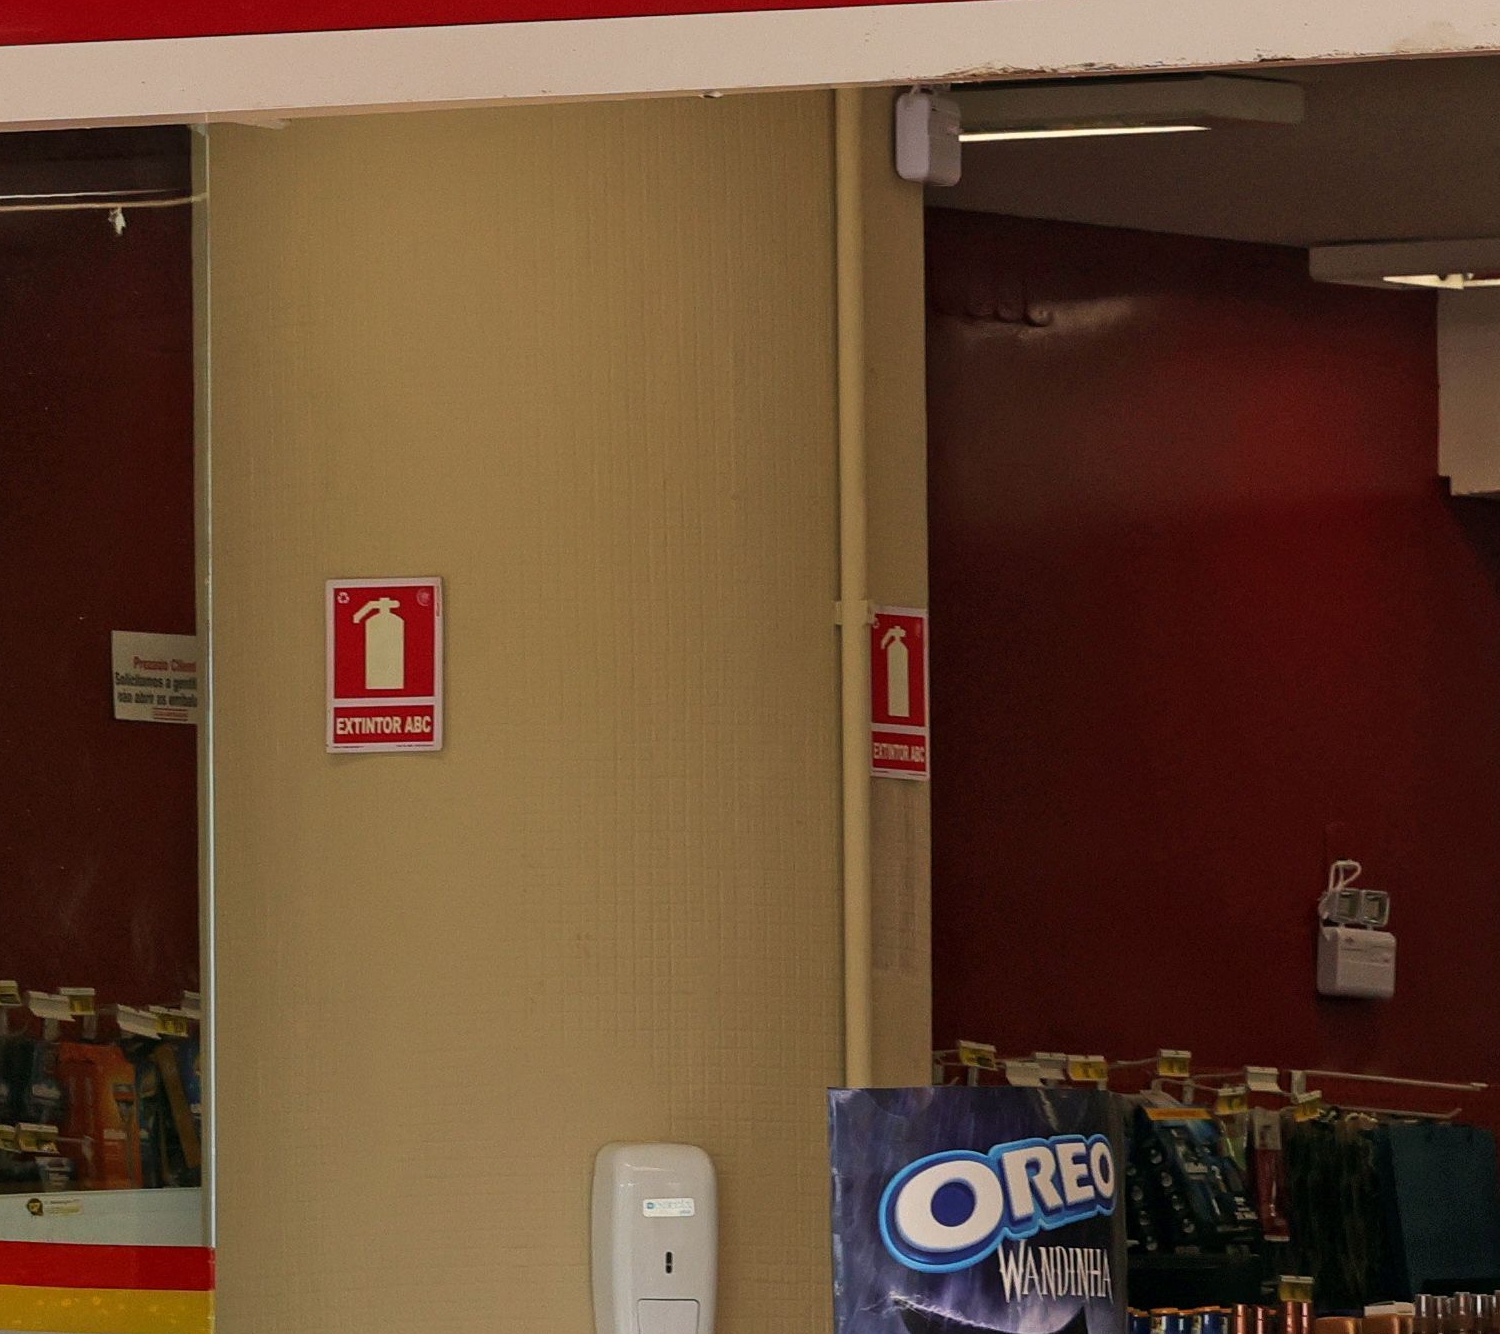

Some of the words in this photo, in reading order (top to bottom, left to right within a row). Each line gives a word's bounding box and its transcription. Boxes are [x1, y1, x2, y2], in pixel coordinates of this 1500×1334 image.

[336, 716, 402, 735] EXTINTOR
[404, 715, 431, 734] ABC
[873, 742, 908, 762] EXTINTOR
[909, 743, 925, 763] ABC
[894, 1141, 1114, 1253] OREO
[998, 1238, 1113, 1303] WANDINHA
